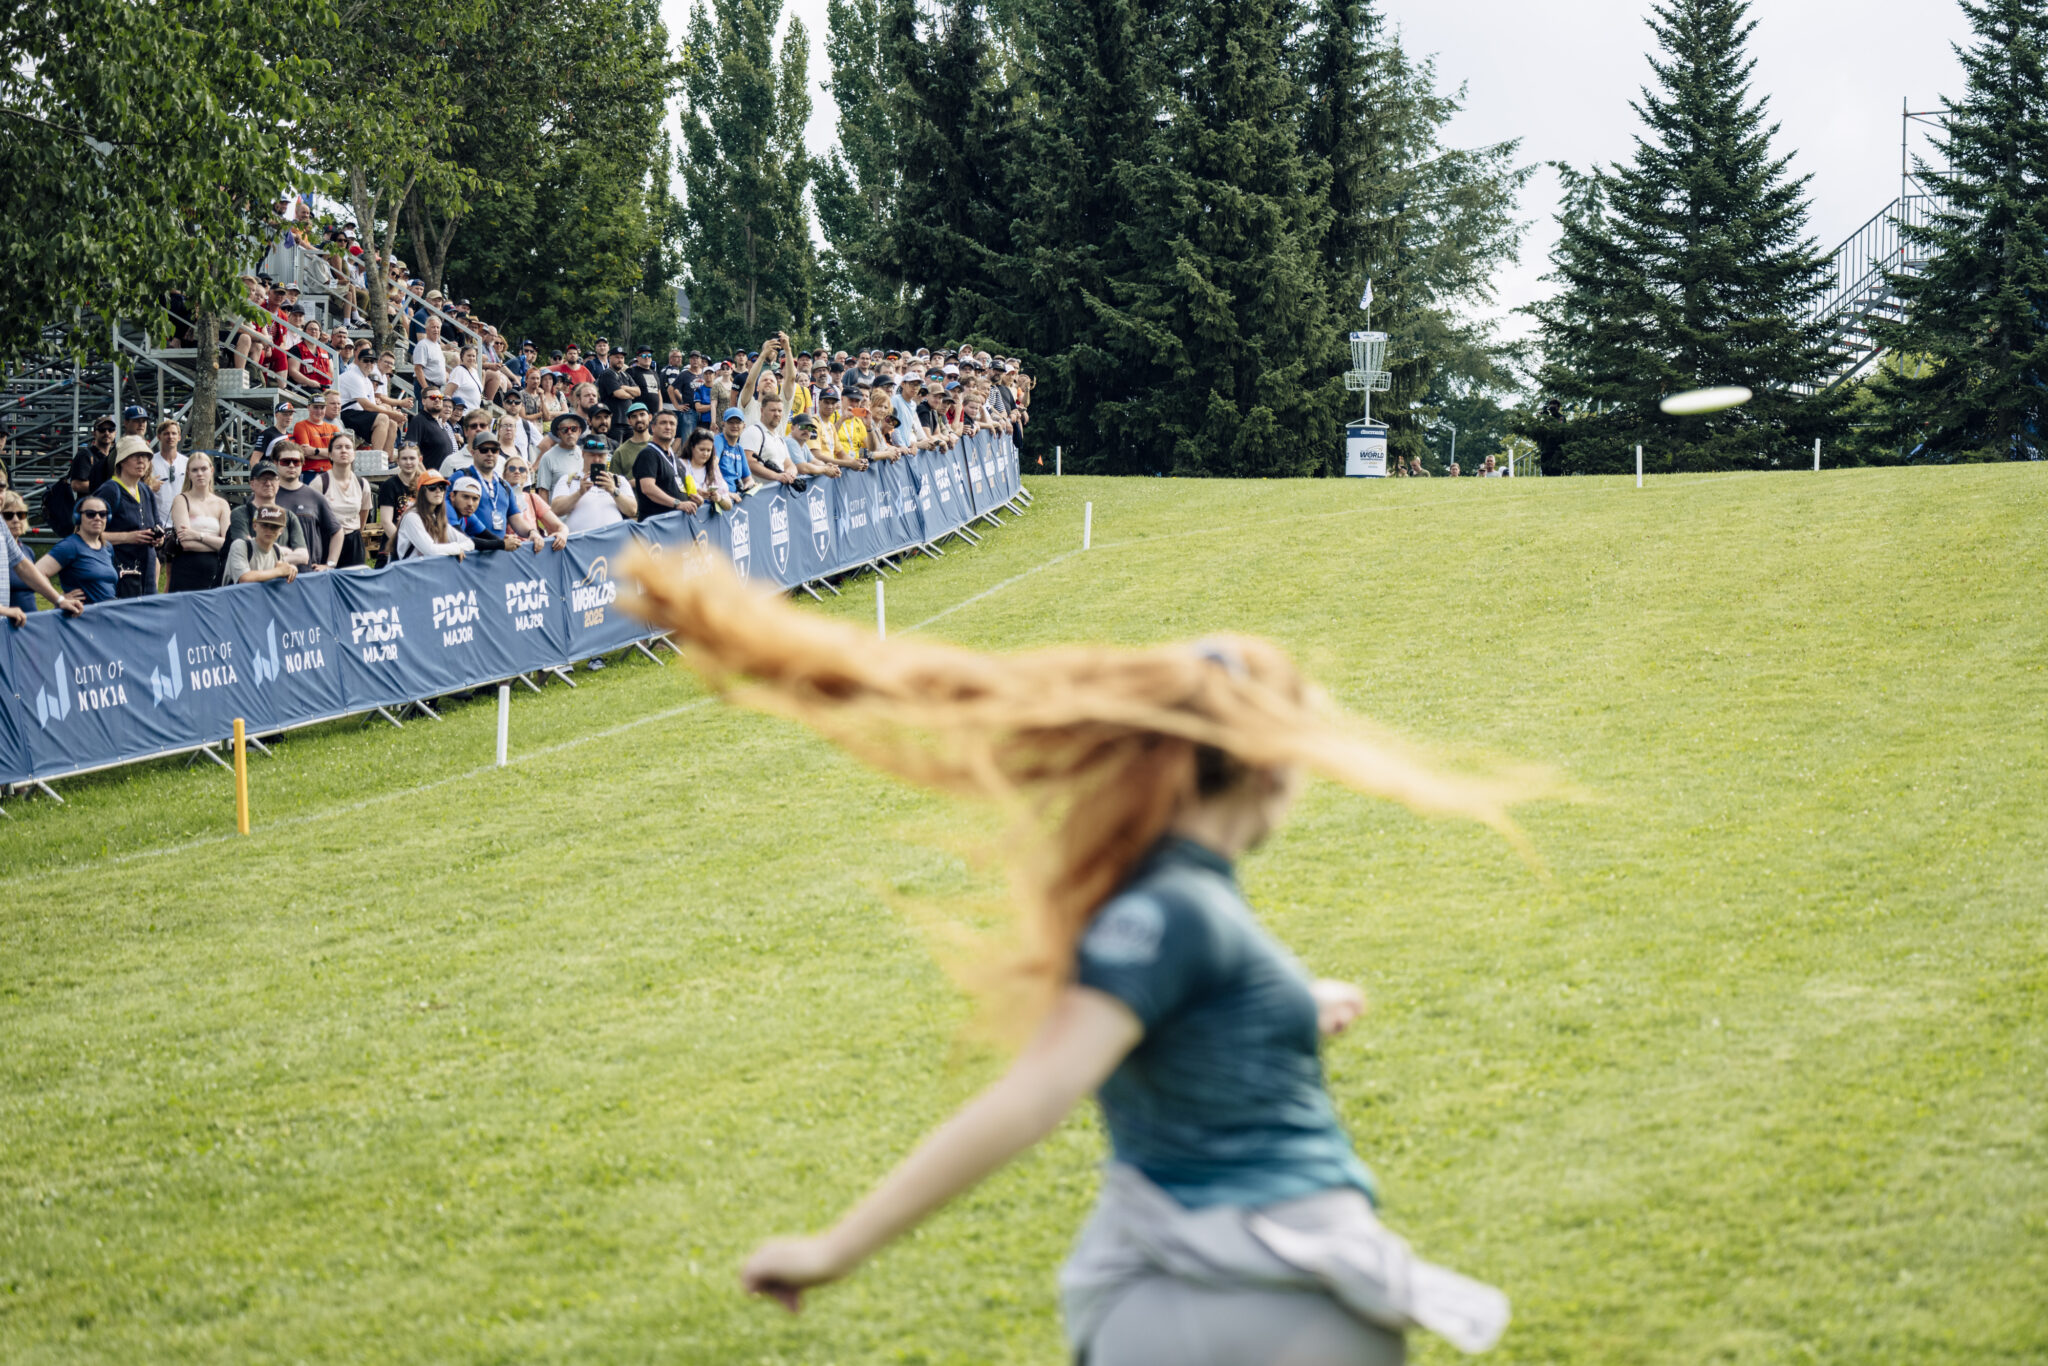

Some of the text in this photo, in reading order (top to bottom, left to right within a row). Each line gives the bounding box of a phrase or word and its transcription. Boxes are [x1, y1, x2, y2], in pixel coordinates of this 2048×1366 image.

[505, 578, 550, 614] PDGA
[572, 580, 616, 613] WORLDS
[432, 589, 480, 629] PDGA
[584, 607, 604, 628] 2025
[350, 606, 404, 644] PDGA
[515, 613, 544, 632] MAJOR
[282, 627, 321, 649] CITY OF
[443, 625, 474, 647] MAJOR
[187, 641, 232, 665] CITY OF
[285, 648, 325, 674] NOKIA
[363, 644, 398, 663] MAJOR
[75, 660, 124, 684] CITY OF
[190, 664, 238, 691] NOKIA
[78, 684, 128, 711] NOKIA
